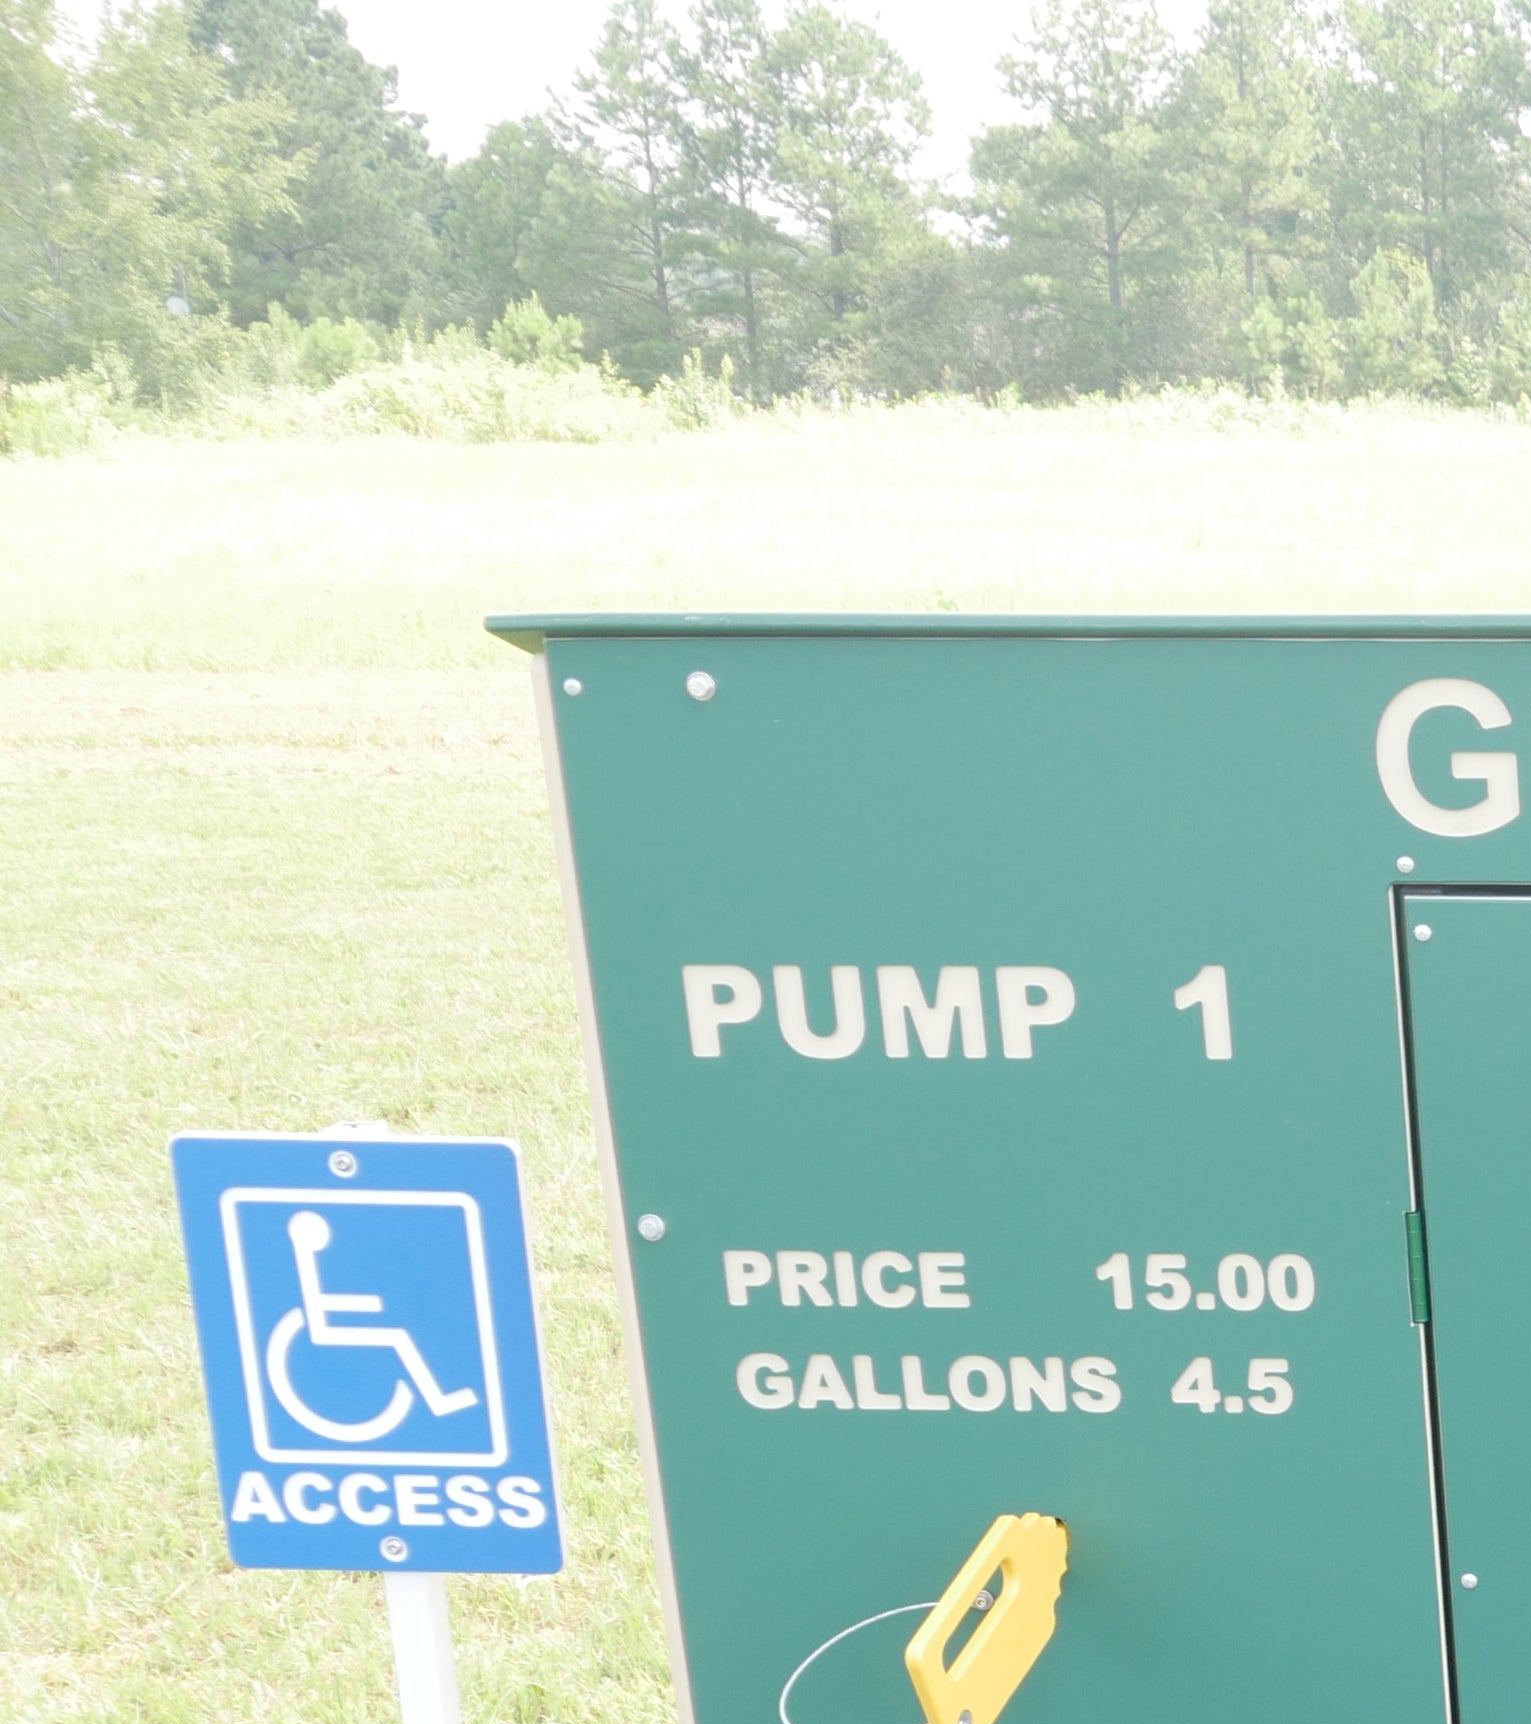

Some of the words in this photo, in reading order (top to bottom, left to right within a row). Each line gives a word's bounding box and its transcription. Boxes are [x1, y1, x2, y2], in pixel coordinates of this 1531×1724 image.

[681, 964, 1077, 1060] PUMP
[1172, 964, 1233, 1061] 1
[722, 1250, 971, 1309] PRICE
[1095, 1252, 1317, 1313] 15.00
[735, 1352, 1122, 1413] GALLONS
[1169, 1356, 1295, 1416] 4.5
[229, 1470, 548, 1529] ACCESS
